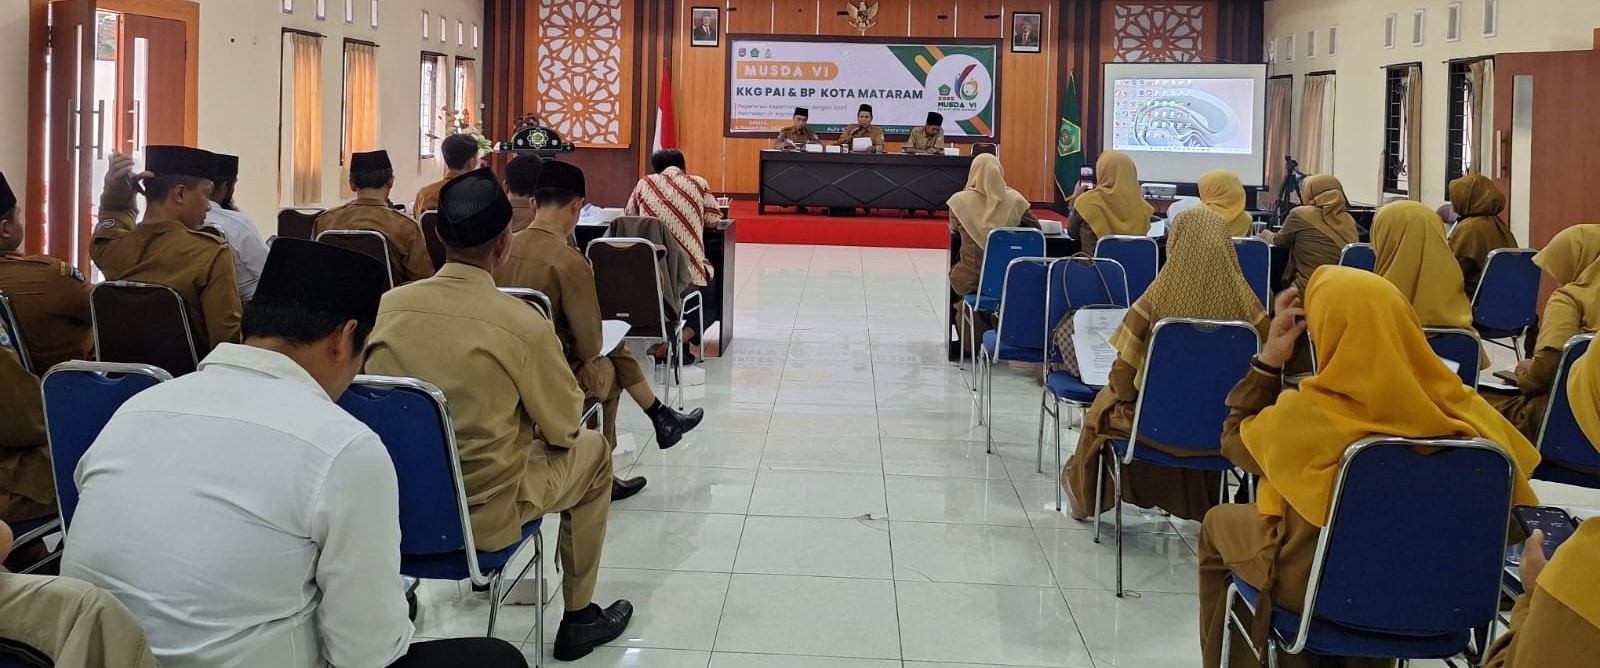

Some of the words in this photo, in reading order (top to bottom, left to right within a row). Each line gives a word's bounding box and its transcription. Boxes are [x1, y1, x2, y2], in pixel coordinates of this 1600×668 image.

[744, 64, 803, 77] MUSDA
[812, 66, 829, 78] VI
[736, 87, 762, 97] KKG
[765, 87, 785, 97] PAI
[788, 88, 797, 97] &
[800, 88, 816, 98] BP
[821, 88, 855, 98] KOTA
[858, 88, 923, 100] MATARAM
